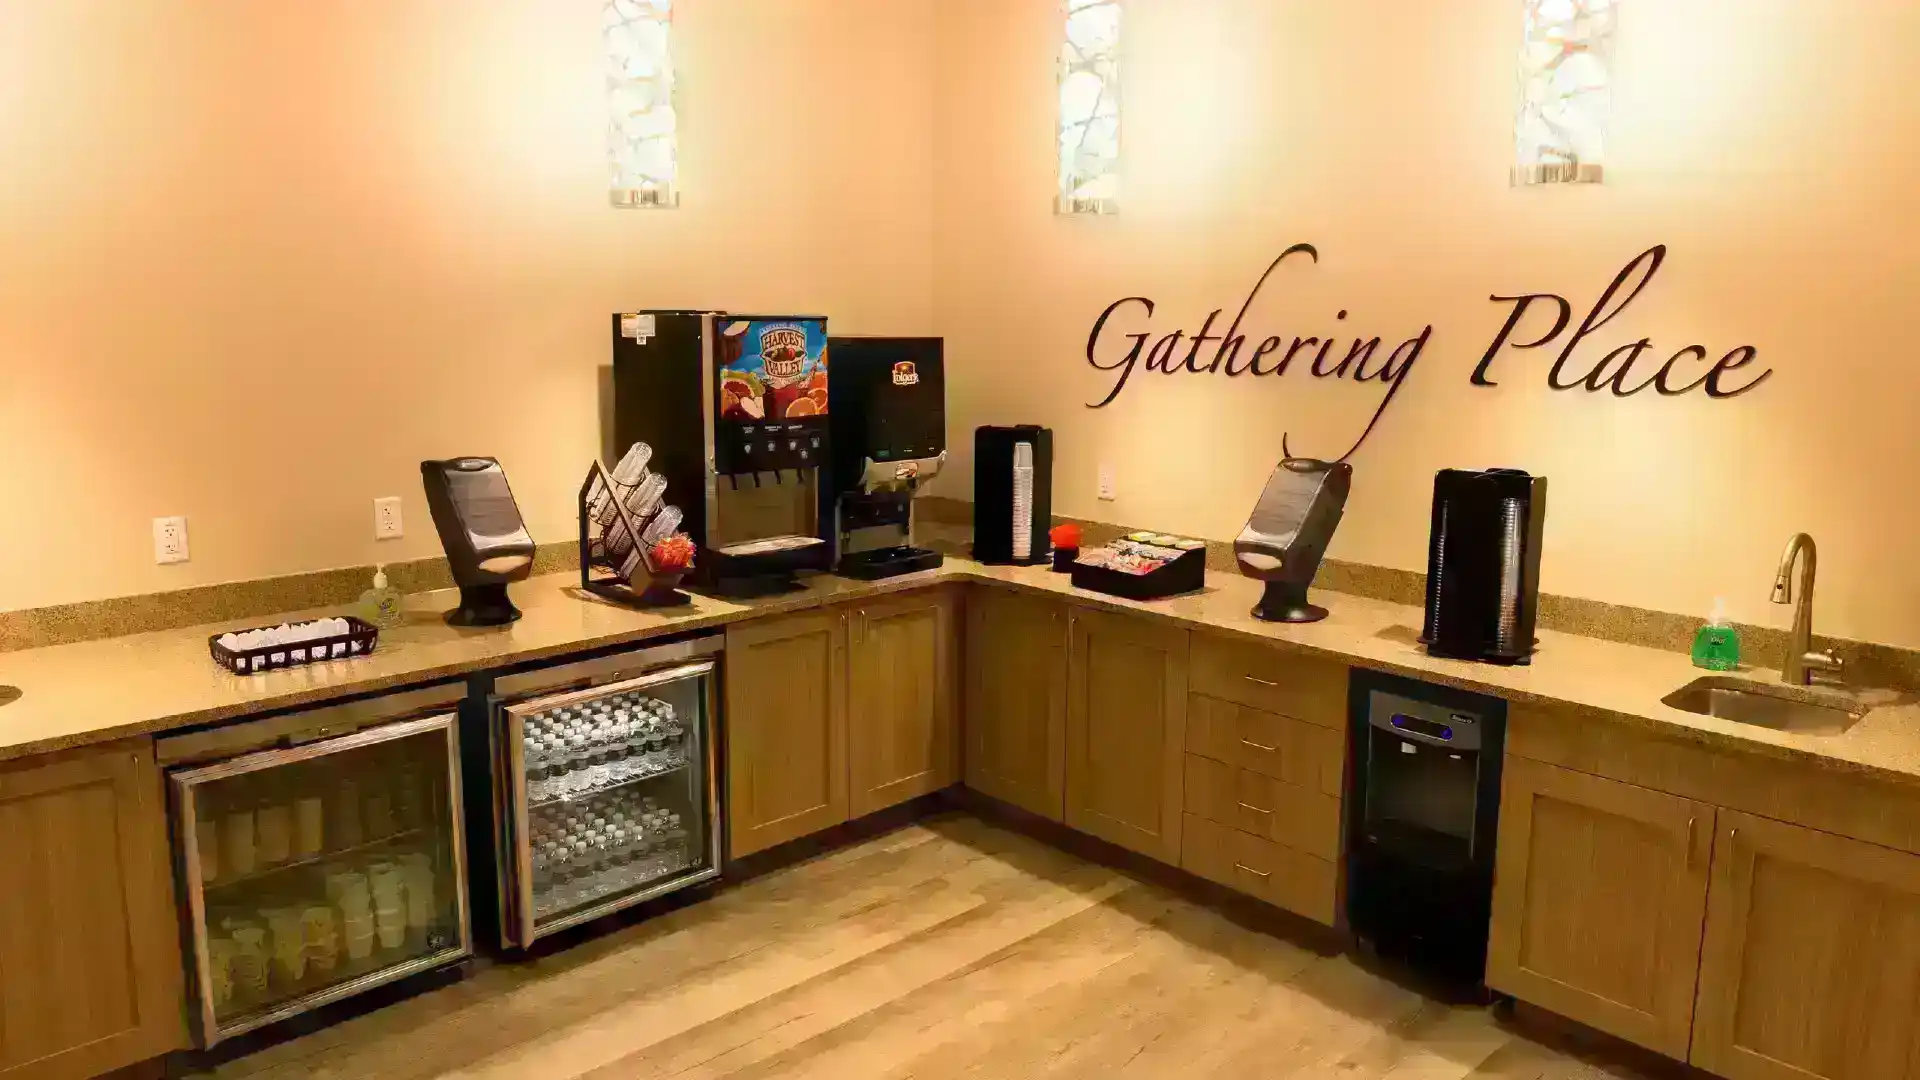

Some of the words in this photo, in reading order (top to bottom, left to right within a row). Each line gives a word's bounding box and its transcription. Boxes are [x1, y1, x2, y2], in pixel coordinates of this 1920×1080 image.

[764, 331, 803, 348] HARVEST
[1085, 243, 1431, 461] Gathering
[1470, 244, 1772, 399] Place
[768, 360, 800, 371] VALLEY
